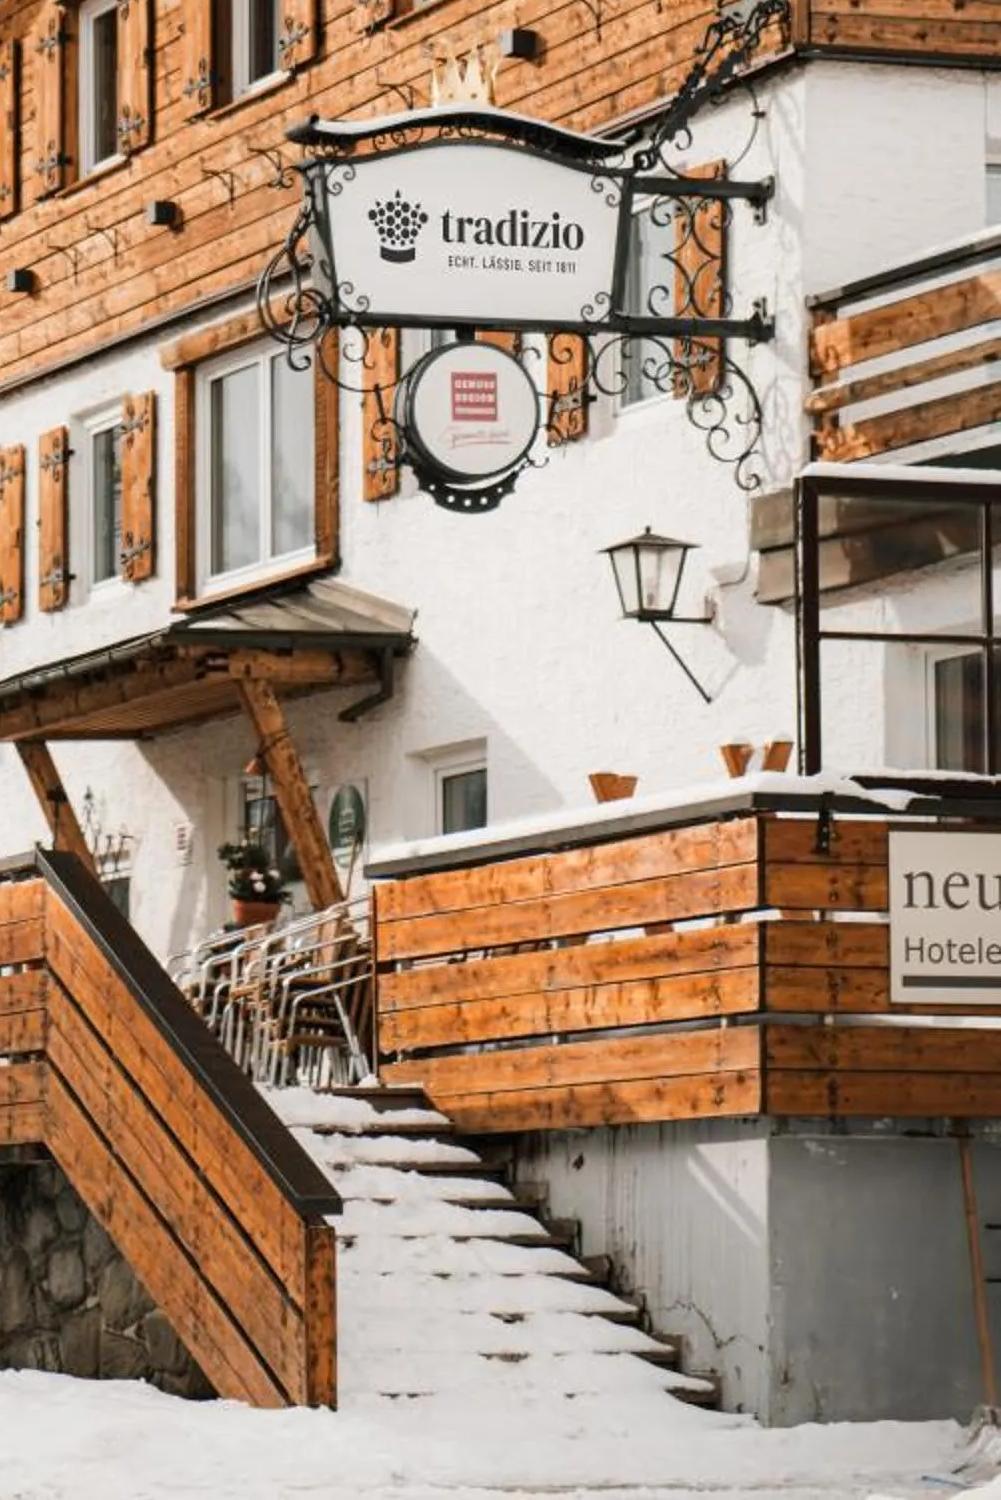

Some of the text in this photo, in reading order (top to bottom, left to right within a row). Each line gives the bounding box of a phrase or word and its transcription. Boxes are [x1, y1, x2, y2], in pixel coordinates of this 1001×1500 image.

[440, 208, 584, 251] tradizio
[903, 870, 1001, 911] neu
[905, 937, 1001, 965] Hotele
